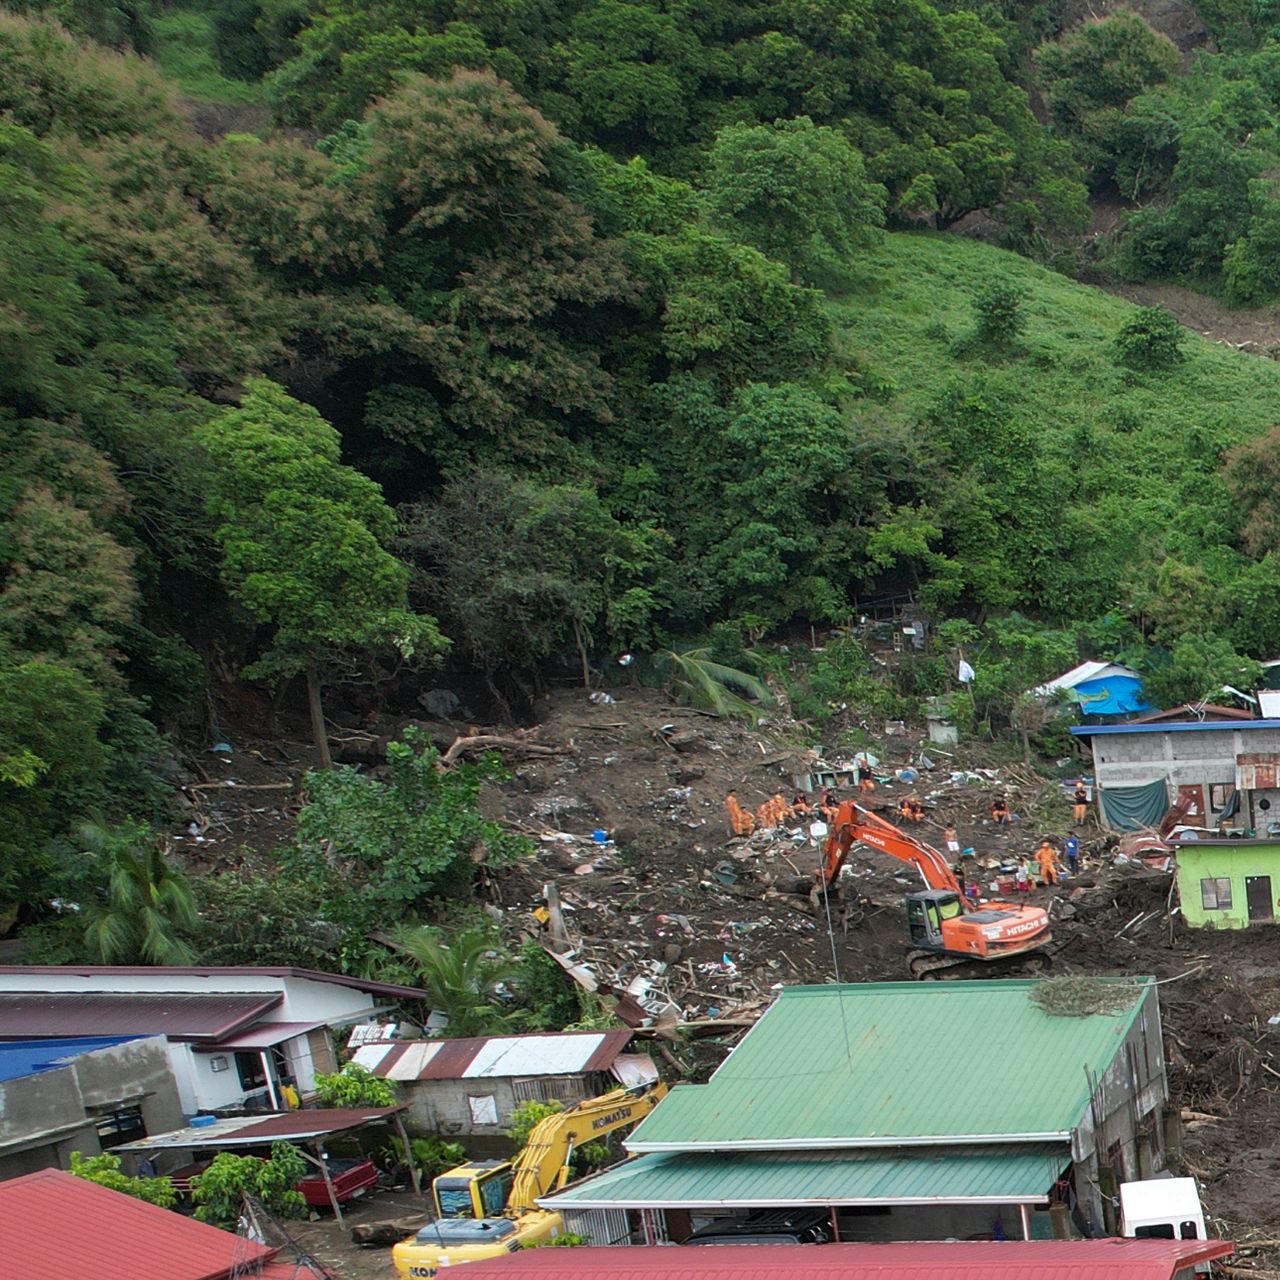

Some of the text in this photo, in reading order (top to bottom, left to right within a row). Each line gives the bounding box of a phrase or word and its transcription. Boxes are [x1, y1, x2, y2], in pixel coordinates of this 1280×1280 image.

[863, 833, 885, 846] HITACHI
[1006, 920, 1039, 936] HITACHI
[592, 1106, 632, 1130] KOMATSU
